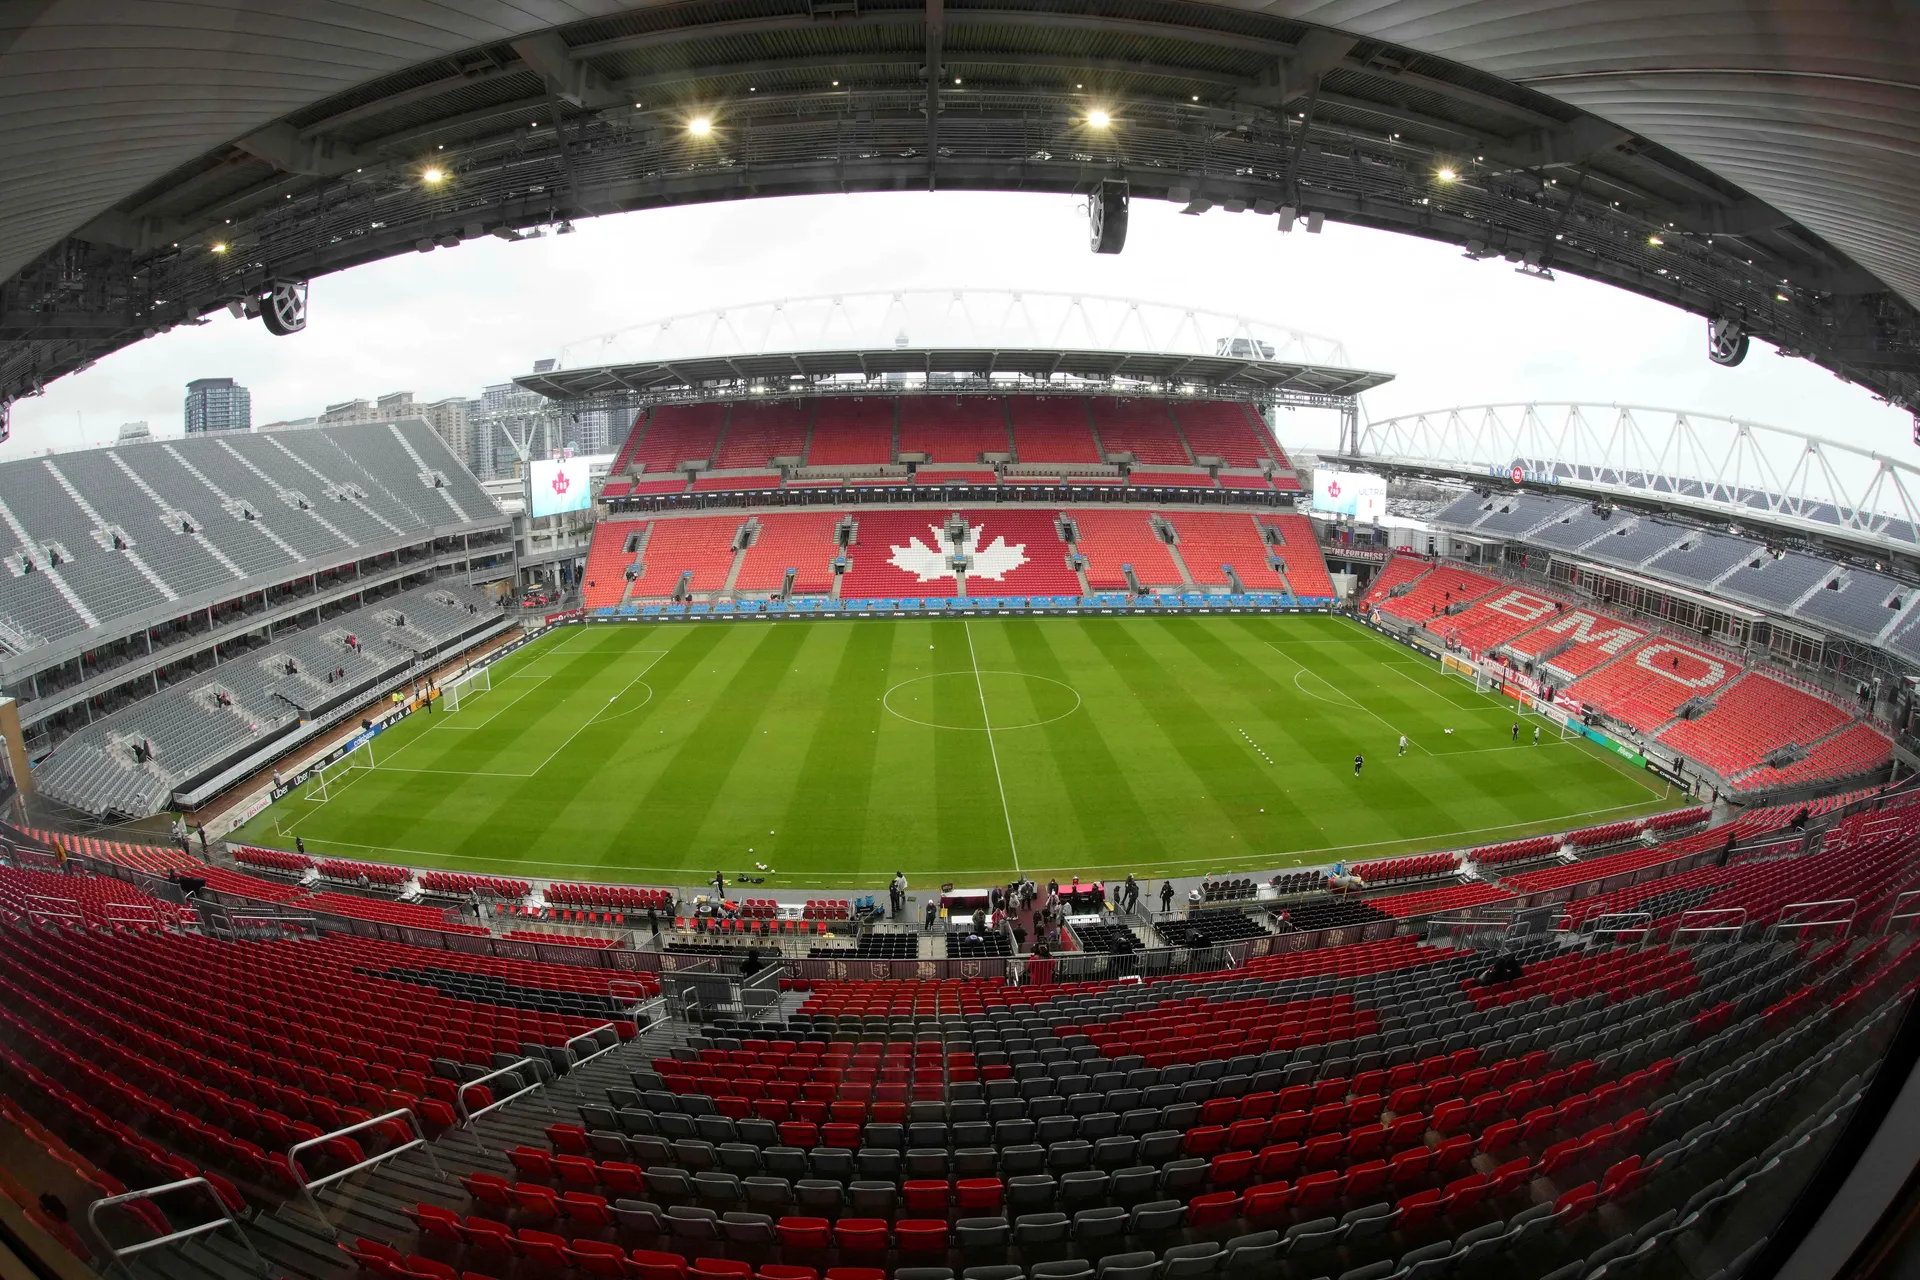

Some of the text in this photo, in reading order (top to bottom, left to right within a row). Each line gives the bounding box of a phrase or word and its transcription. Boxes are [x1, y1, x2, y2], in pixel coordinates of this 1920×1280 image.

[1489, 466, 1560, 485] BMO FIELD
[1358, 488, 1385, 496] ULTRA
[1332, 548, 1384, 560] THE FORTRESS
[1485, 590, 1725, 688] BMO
[294, 772, 308, 785] Uber
[1660, 771, 1688, 789] CHEVROLET
[273, 785, 289, 799] Uber
